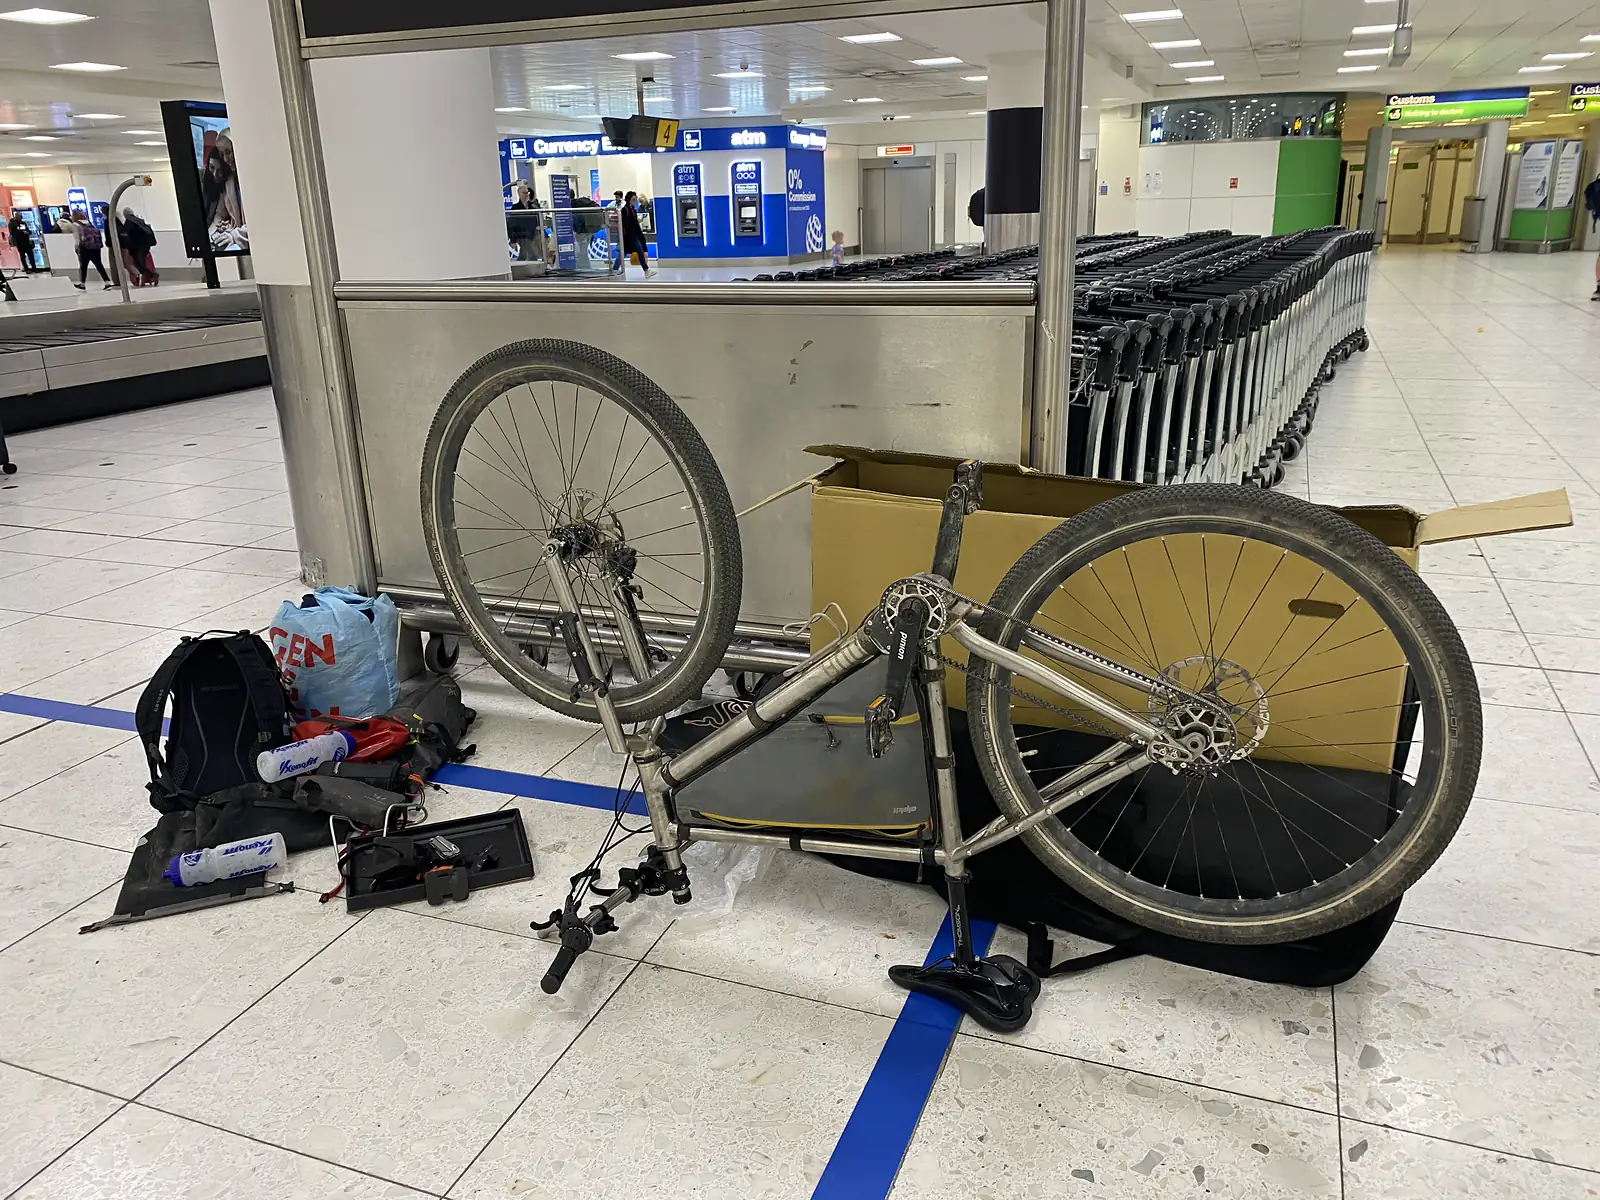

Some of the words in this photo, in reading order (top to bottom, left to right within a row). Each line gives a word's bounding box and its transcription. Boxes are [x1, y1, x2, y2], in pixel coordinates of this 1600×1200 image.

[1389, 94, 1435, 105] Customs
[663, 124, 671, 144] 4
[730, 129, 766, 146] atm
[533, 138, 600, 155] Currency
[677, 165, 695, 174] atm
[736, 162, 756, 172] atm
[788, 168, 803, 190] 0%
[459, 610, 499, 661] SCHWALBE
[269, 626, 336, 668] GEN
[897, 631, 908, 660] pinion
[279, 757, 319, 776] Xenofit
[223, 839, 273, 856] Xenofit
[954, 905, 963, 947] THOMSON
